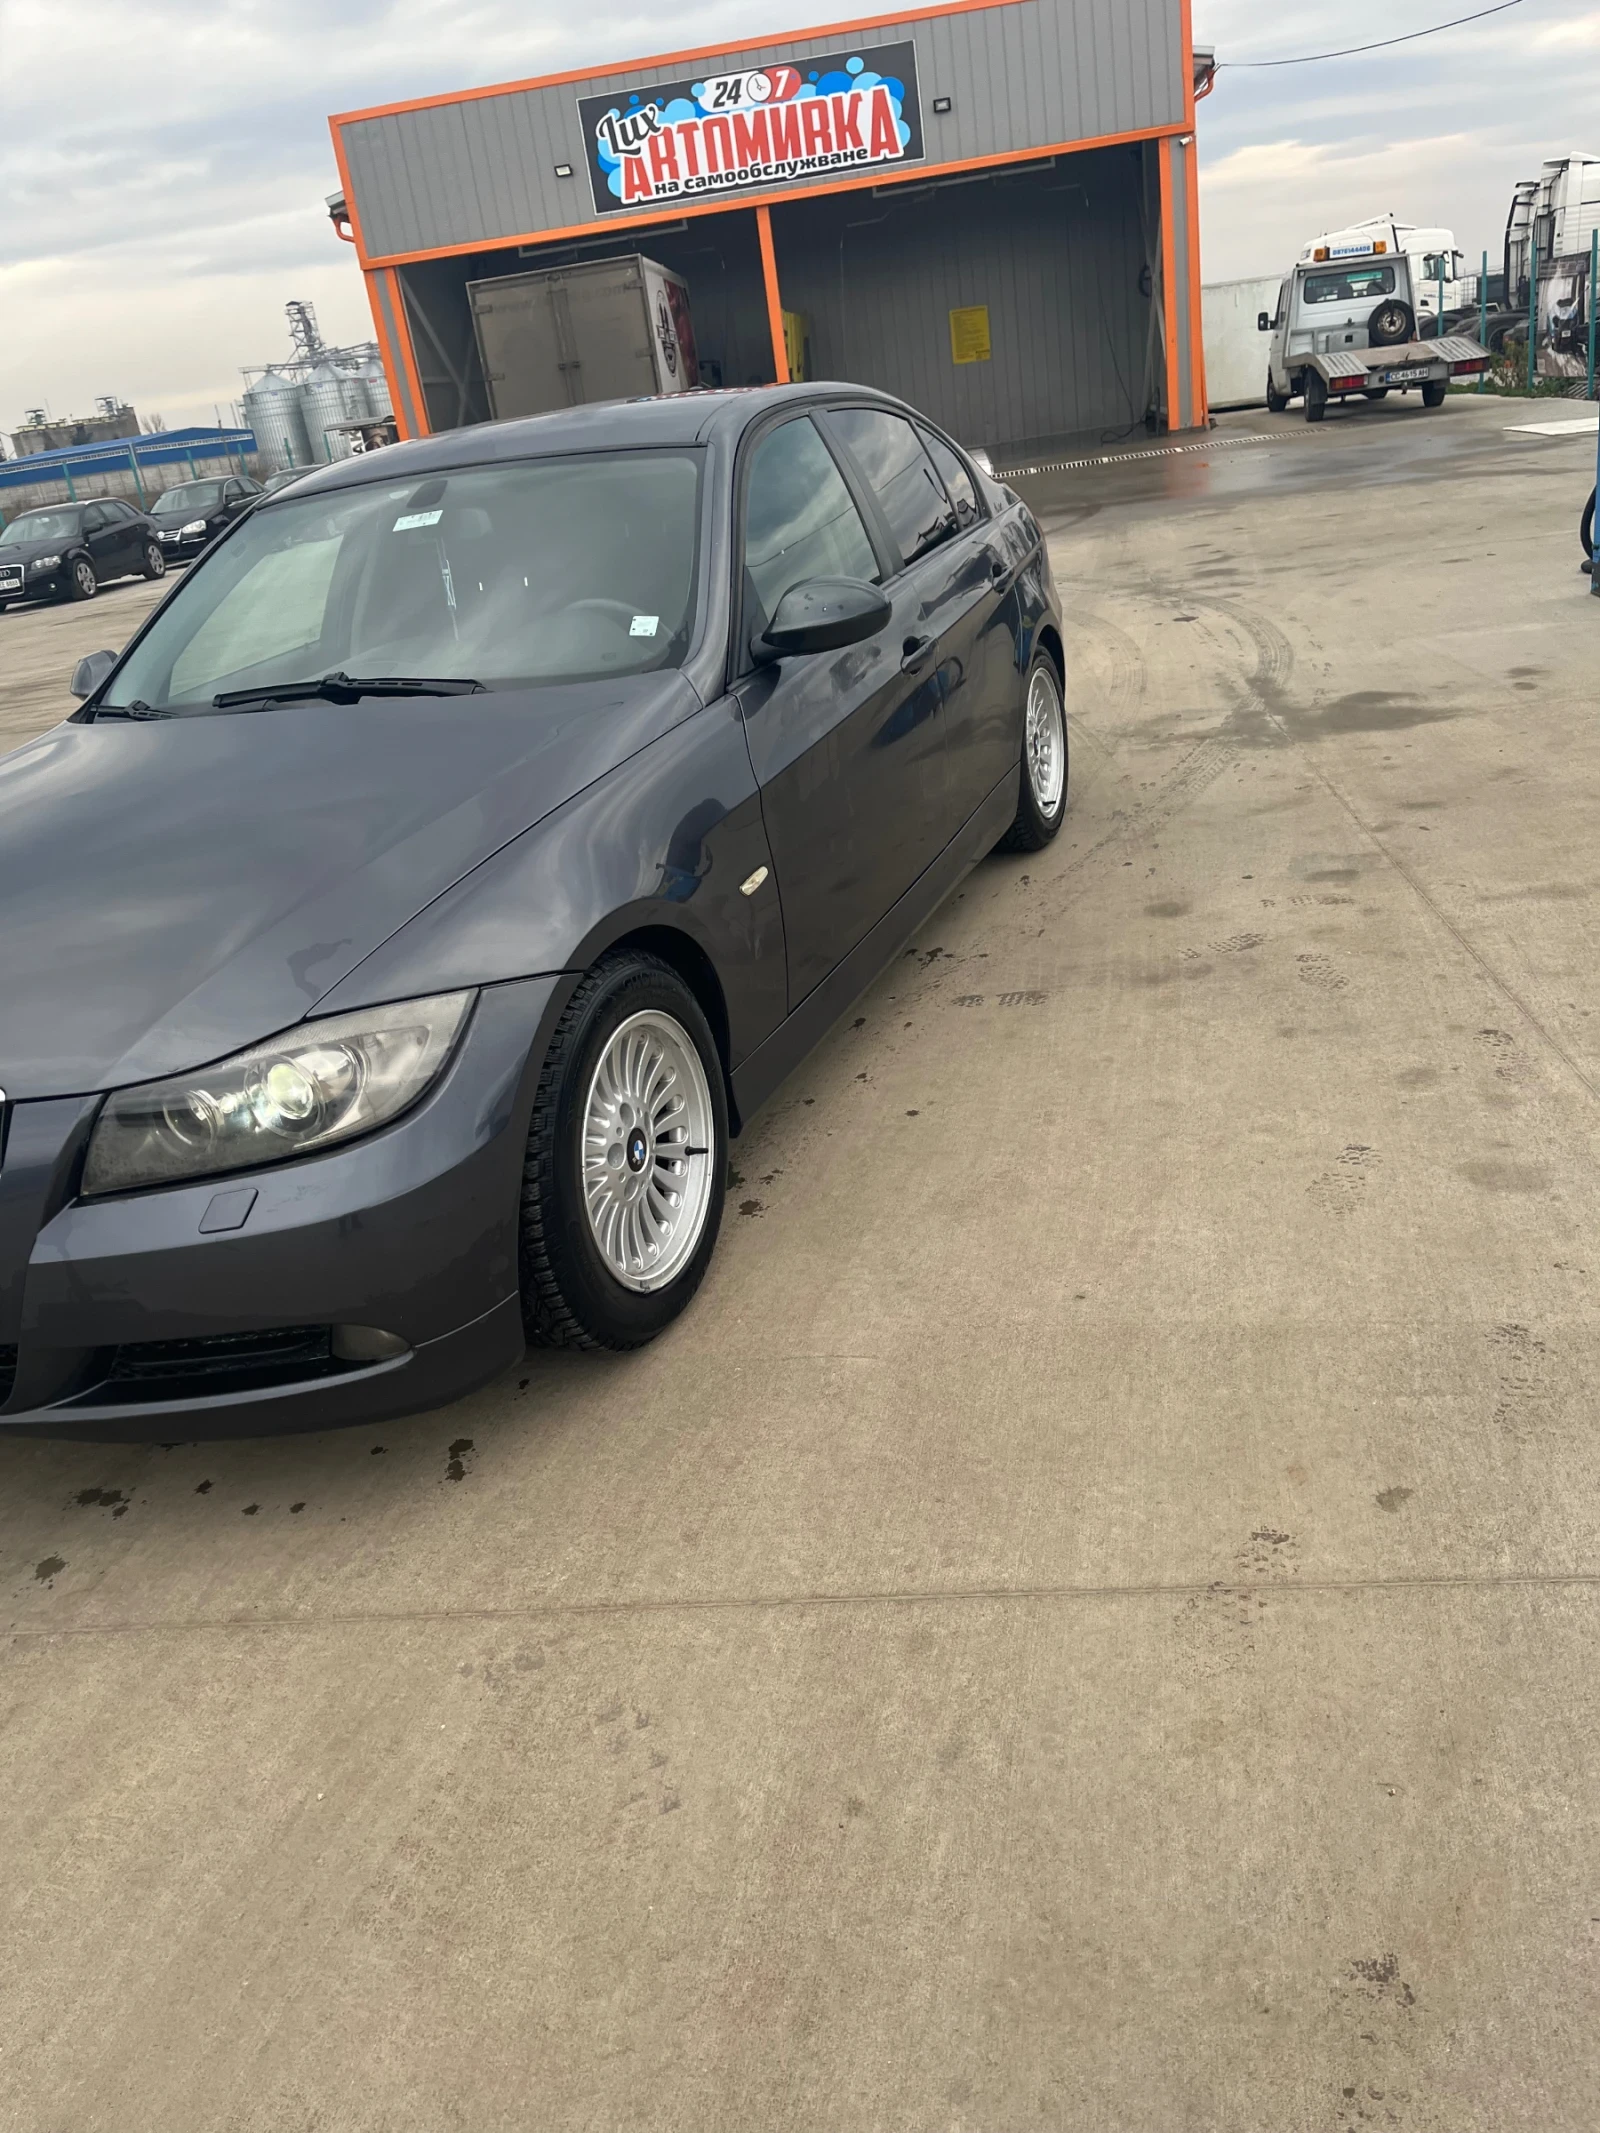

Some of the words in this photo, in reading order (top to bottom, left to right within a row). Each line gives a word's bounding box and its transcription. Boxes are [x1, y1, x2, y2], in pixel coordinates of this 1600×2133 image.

[712, 77, 742, 109] 24
[775, 69, 790, 98] 7
[598, 105, 661, 155] Lux
[654, 181, 680, 196] на
[683, 147, 869, 192] самообслужване
